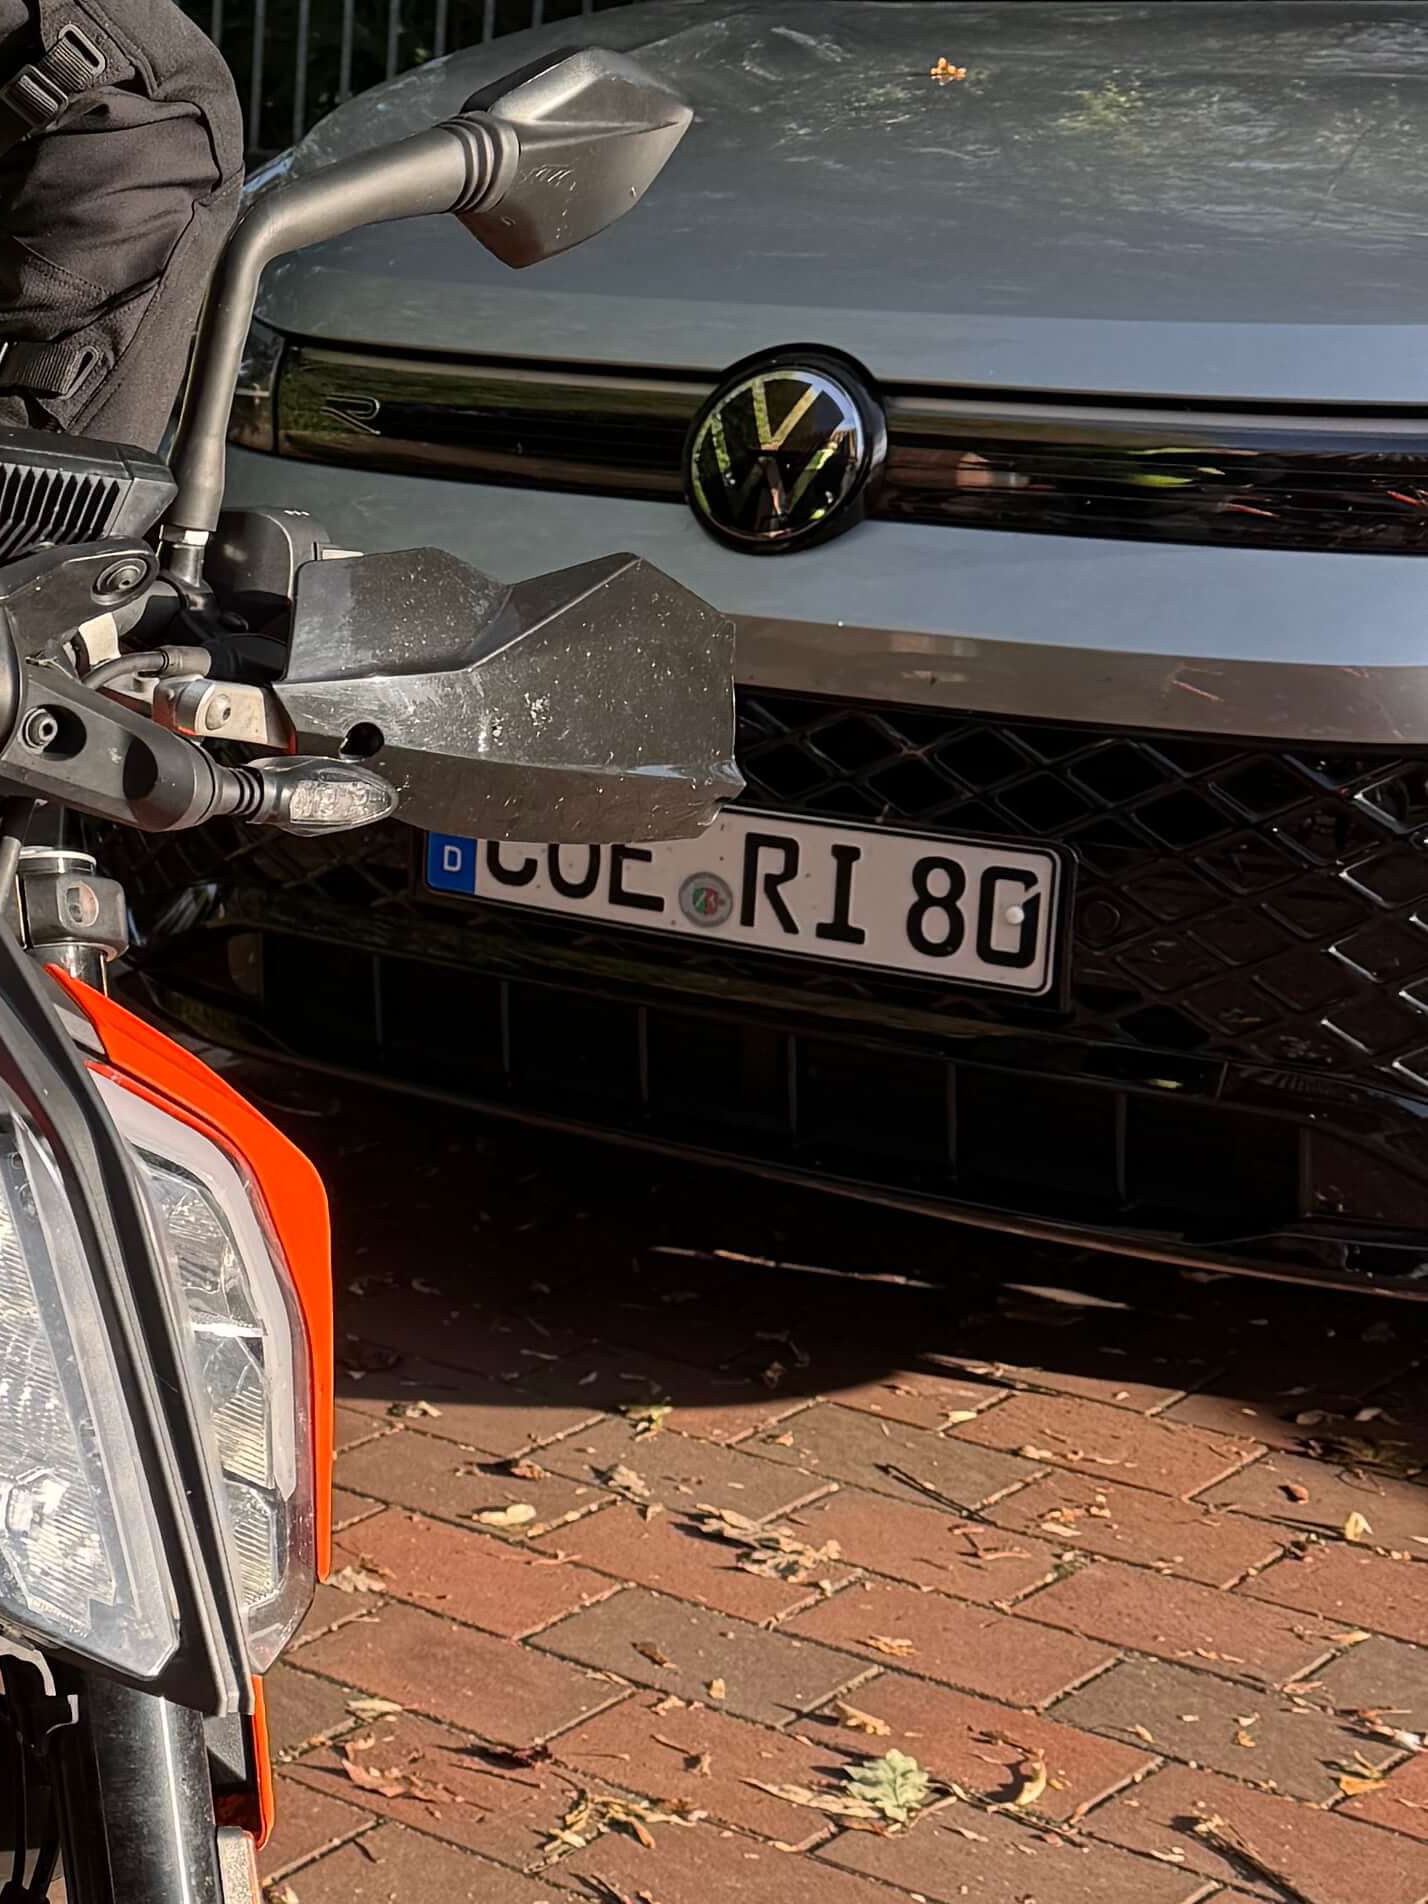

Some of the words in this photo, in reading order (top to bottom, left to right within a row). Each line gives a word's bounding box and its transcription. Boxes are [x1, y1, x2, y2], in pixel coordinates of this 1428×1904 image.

[443, 845, 463, 873] D
[740, 831, 867, 946] RI
[905, 856, 1040, 970] 80
